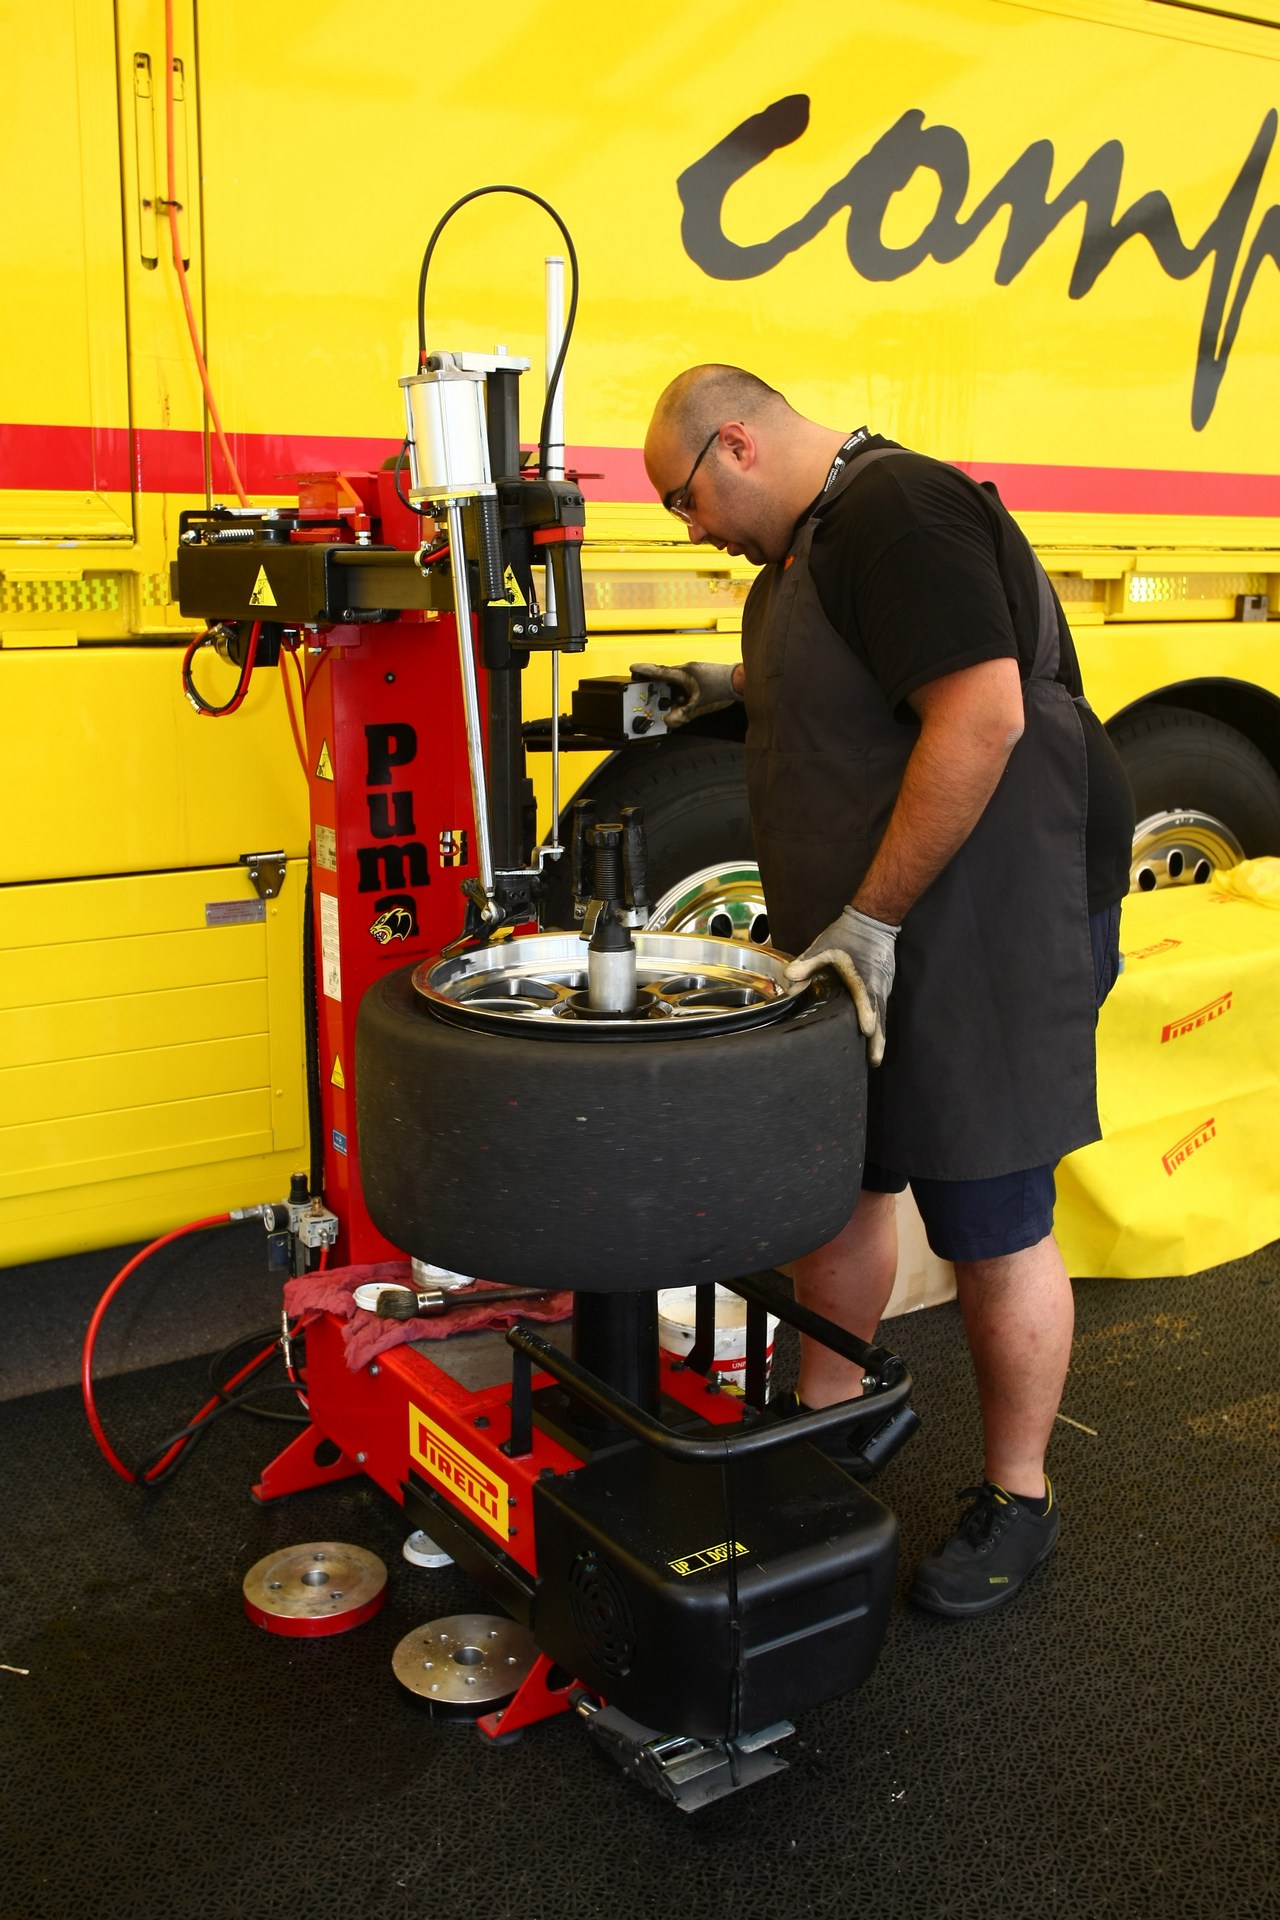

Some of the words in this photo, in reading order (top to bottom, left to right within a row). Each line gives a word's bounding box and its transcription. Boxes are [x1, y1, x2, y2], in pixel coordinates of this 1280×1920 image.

[1161, 991, 1233, 1043] PIRELLI
[1161, 1118, 1217, 1176] PIRELLI
[418, 1421, 498, 1521] PIRELLI
[670, 1561, 690, 1574] UP
[706, 1541, 748, 1561] DON
